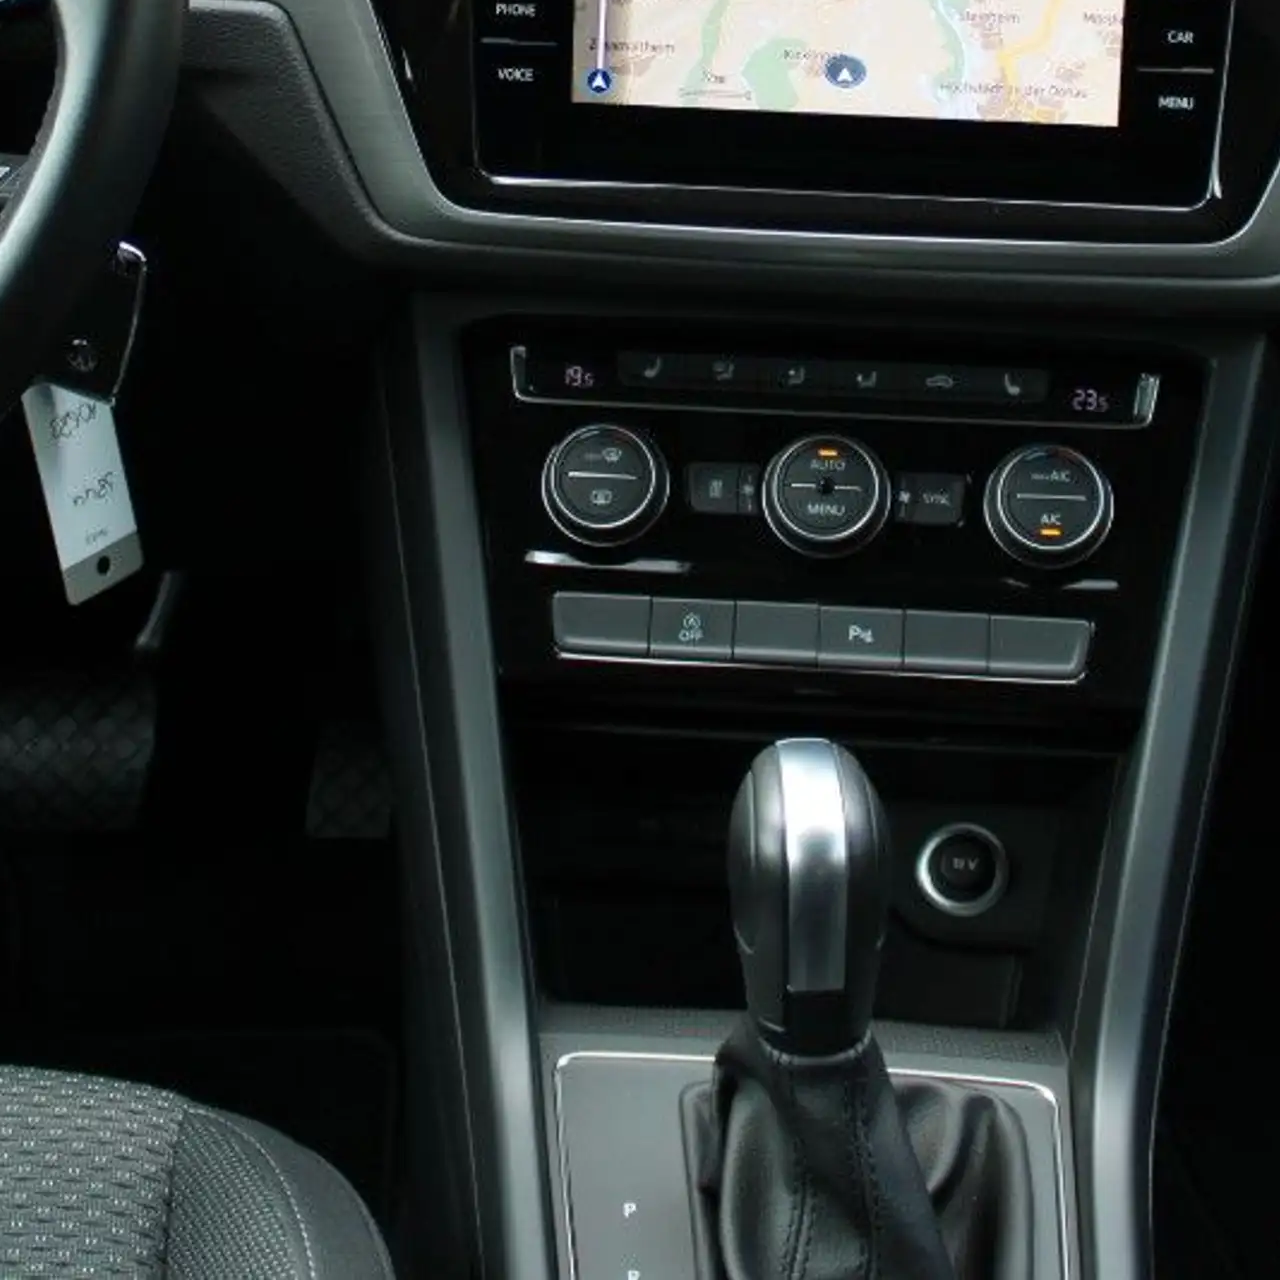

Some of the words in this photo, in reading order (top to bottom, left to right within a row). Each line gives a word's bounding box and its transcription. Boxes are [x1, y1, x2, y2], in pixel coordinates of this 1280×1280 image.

[495, 2, 537, 18] PHONE
[1167, 30, 1195, 44] CAR
[497, 67, 535, 82] VOICE
[1157, 95, 1195, 110] MENU
[809, 459, 846, 471] AUTO
[807, 503, 846, 517] MENU
[623, 1202, 637, 1218] P
